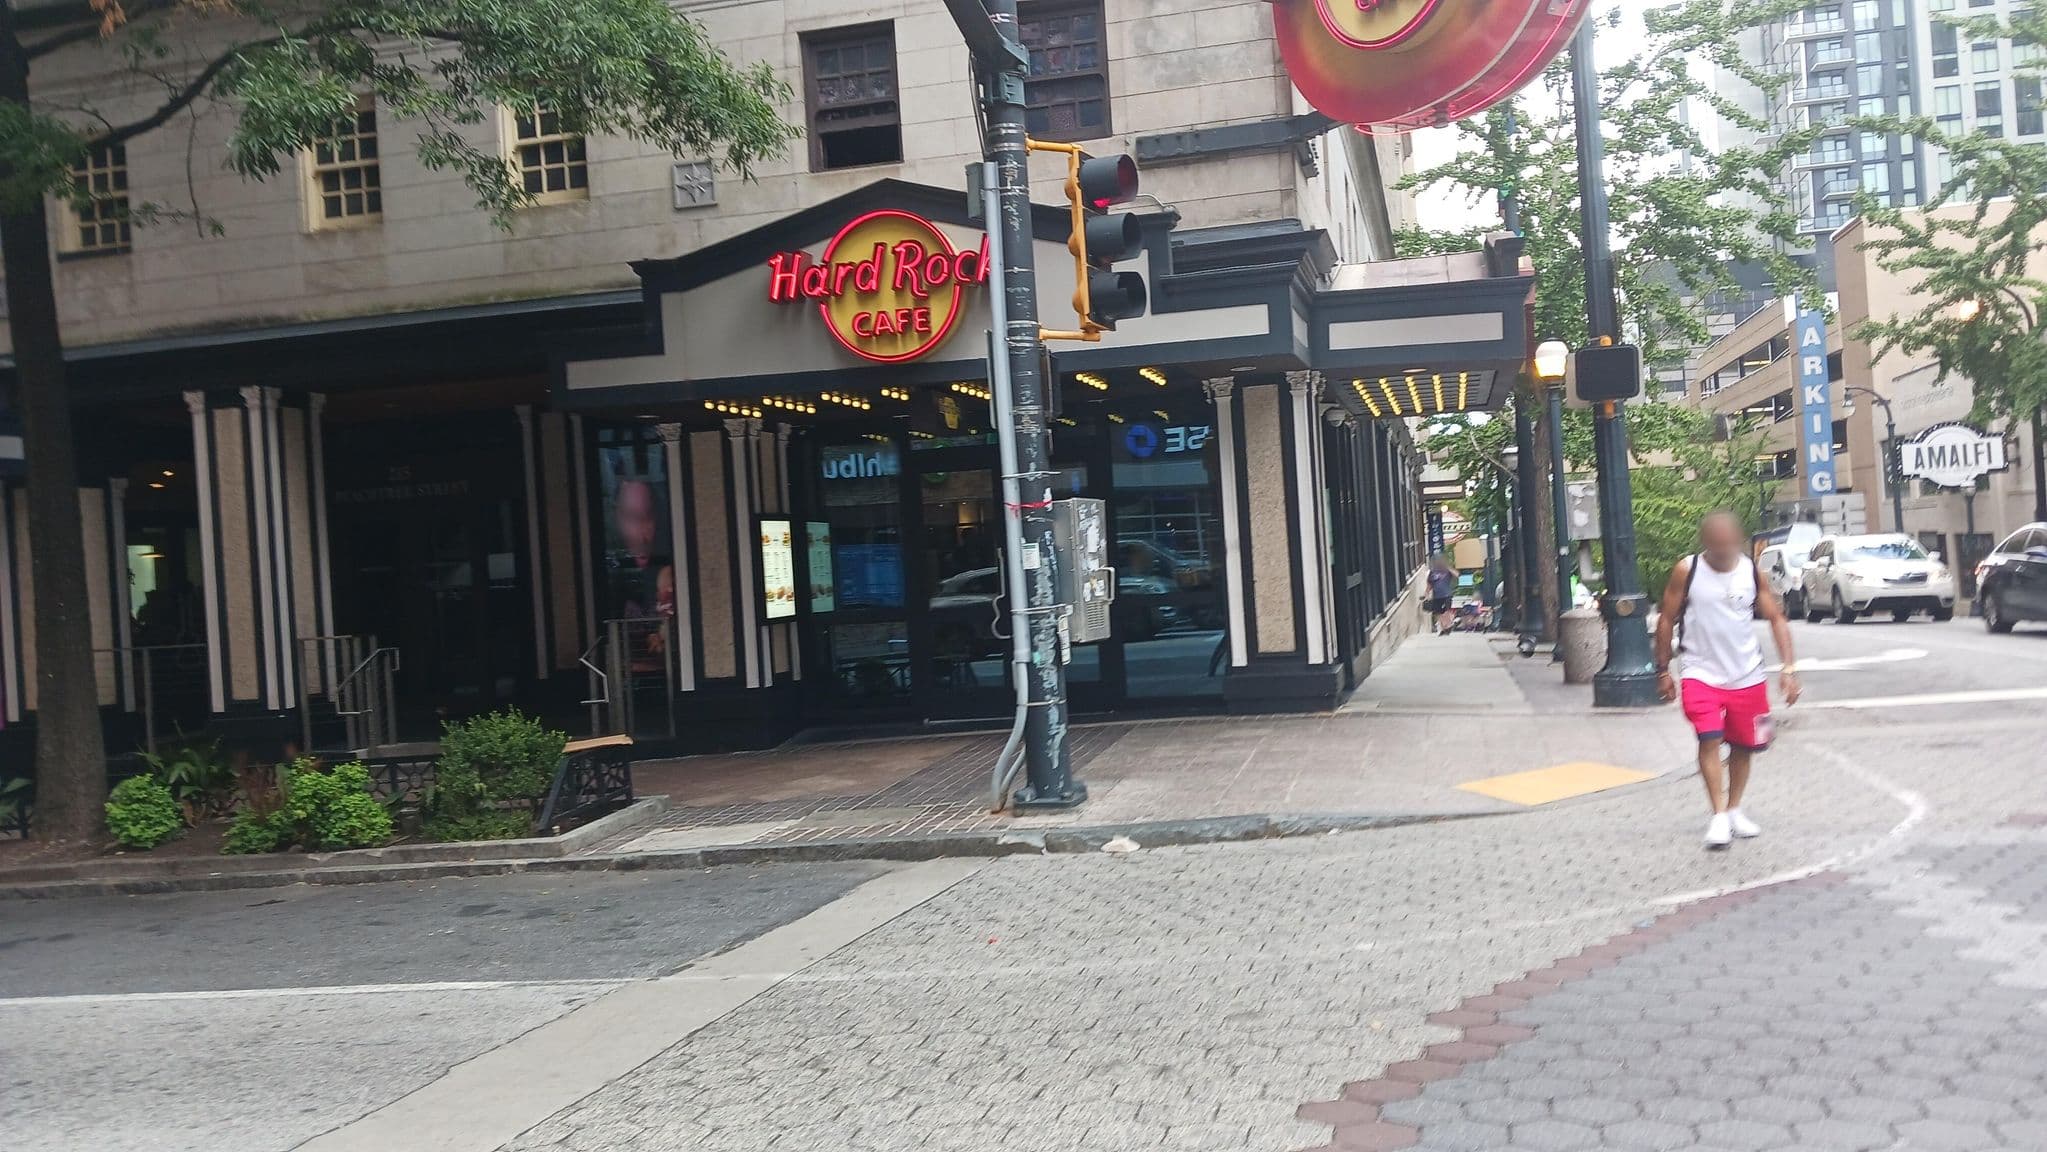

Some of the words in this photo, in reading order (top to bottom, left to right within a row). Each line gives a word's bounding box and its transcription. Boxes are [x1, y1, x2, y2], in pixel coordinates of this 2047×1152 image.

[768, 242, 888, 303] Hard
[852, 306, 931, 337] CAFE
[1799, 309, 1833, 493] ARKING
[1914, 442, 1993, 470] AMALFI
